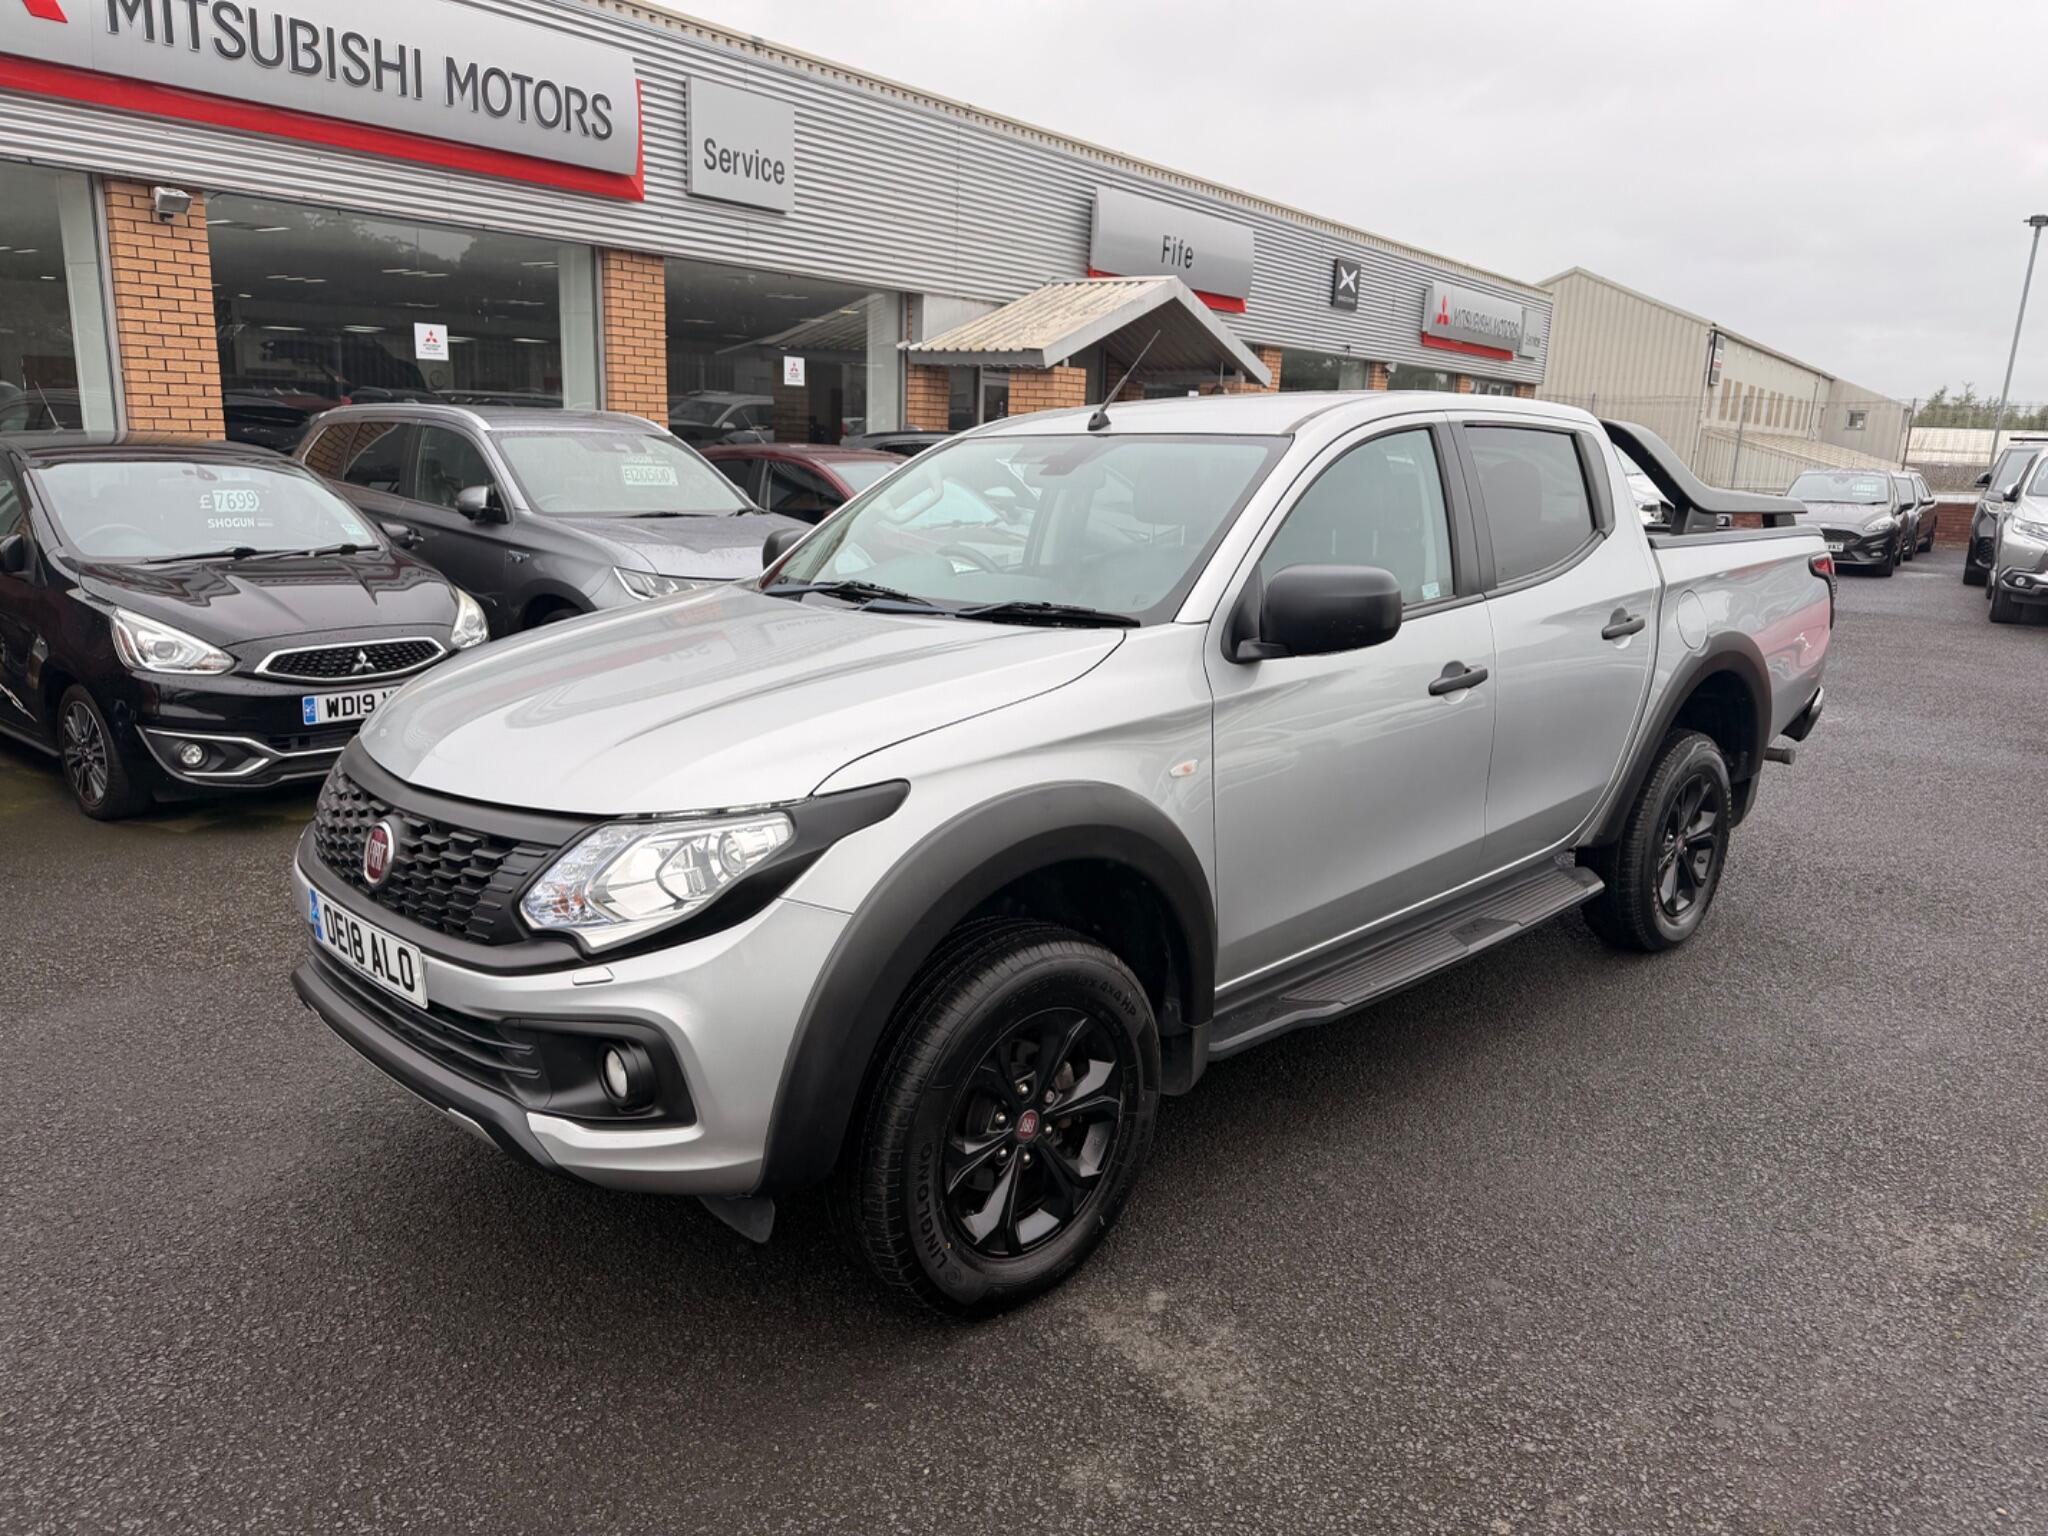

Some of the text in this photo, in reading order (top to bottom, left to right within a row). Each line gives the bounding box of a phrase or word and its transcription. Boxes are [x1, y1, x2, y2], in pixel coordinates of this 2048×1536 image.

[106, 0, 614, 141] MITSUBISHI MOTORS
[703, 137, 785, 186] Service
[1161, 234, 1194, 269] Fife
[200, 491, 257, 510] £7699
[207, 517, 256, 529] SHOGUN
[325, 693, 376, 718] WD19
[369, 838, 387, 871] FIAT
[323, 903, 415, 993] OE18 ALO
